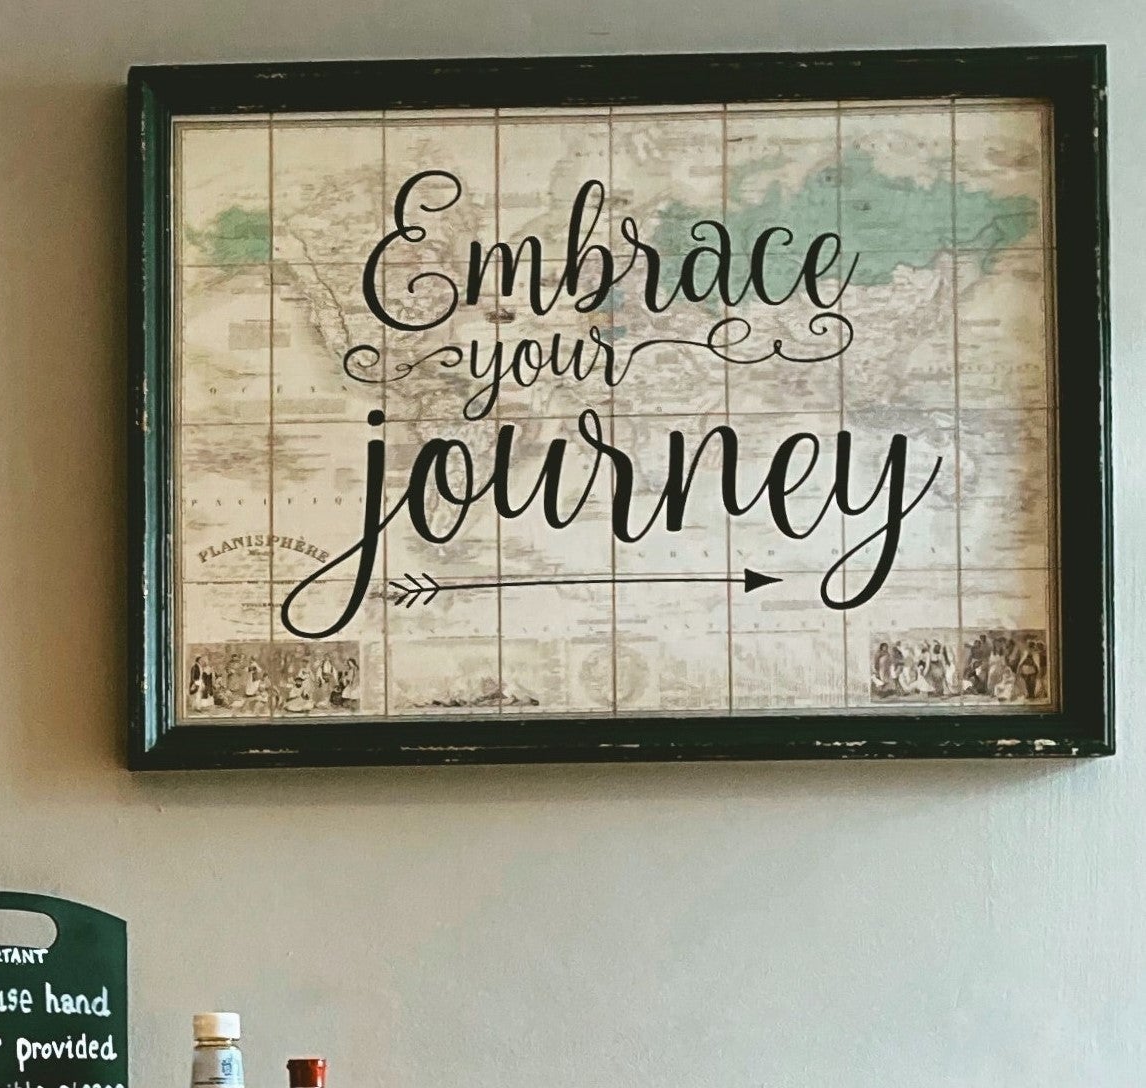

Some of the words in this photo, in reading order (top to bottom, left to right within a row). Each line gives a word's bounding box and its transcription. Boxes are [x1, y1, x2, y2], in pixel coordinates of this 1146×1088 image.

[361, 169, 860, 332] Embrace
[461, 325, 637, 421] your
[280, 409, 943, 640] journey
[45, 981, 112, 1018] hand
[16, 1033, 118, 1073] provided
